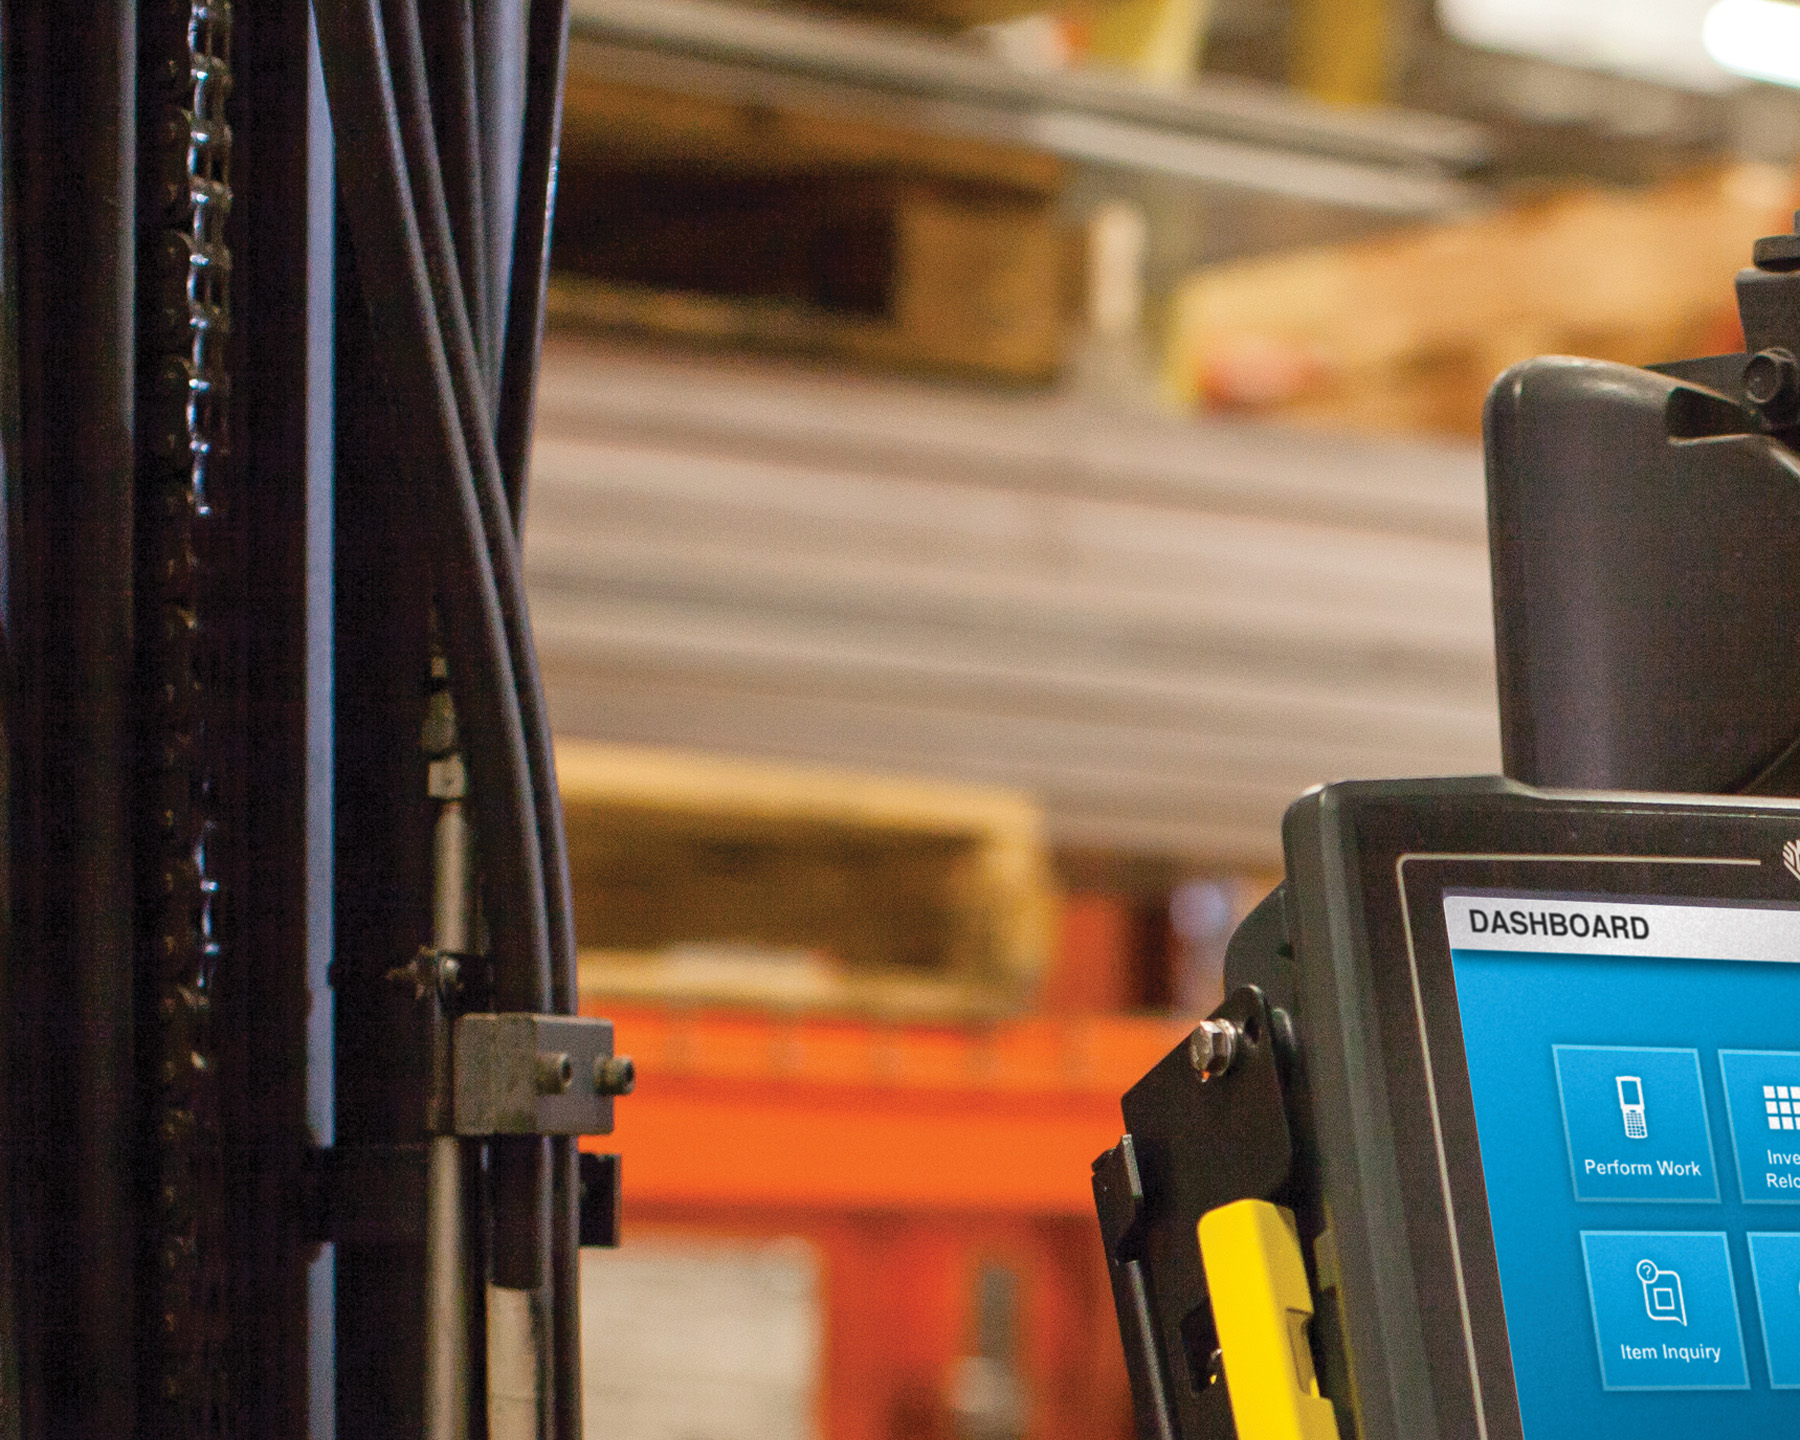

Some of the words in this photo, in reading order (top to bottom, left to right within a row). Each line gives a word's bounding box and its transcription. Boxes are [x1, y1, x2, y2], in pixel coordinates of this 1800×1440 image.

[1469, 909, 1650, 940] DASHBOARD
[1584, 1159, 1652, 1176] Perform
[1656, 1160, 1701, 1176] Work
[1620, 1343, 1658, 1360] Item
[1663, 1343, 1721, 1363] Inquiry
